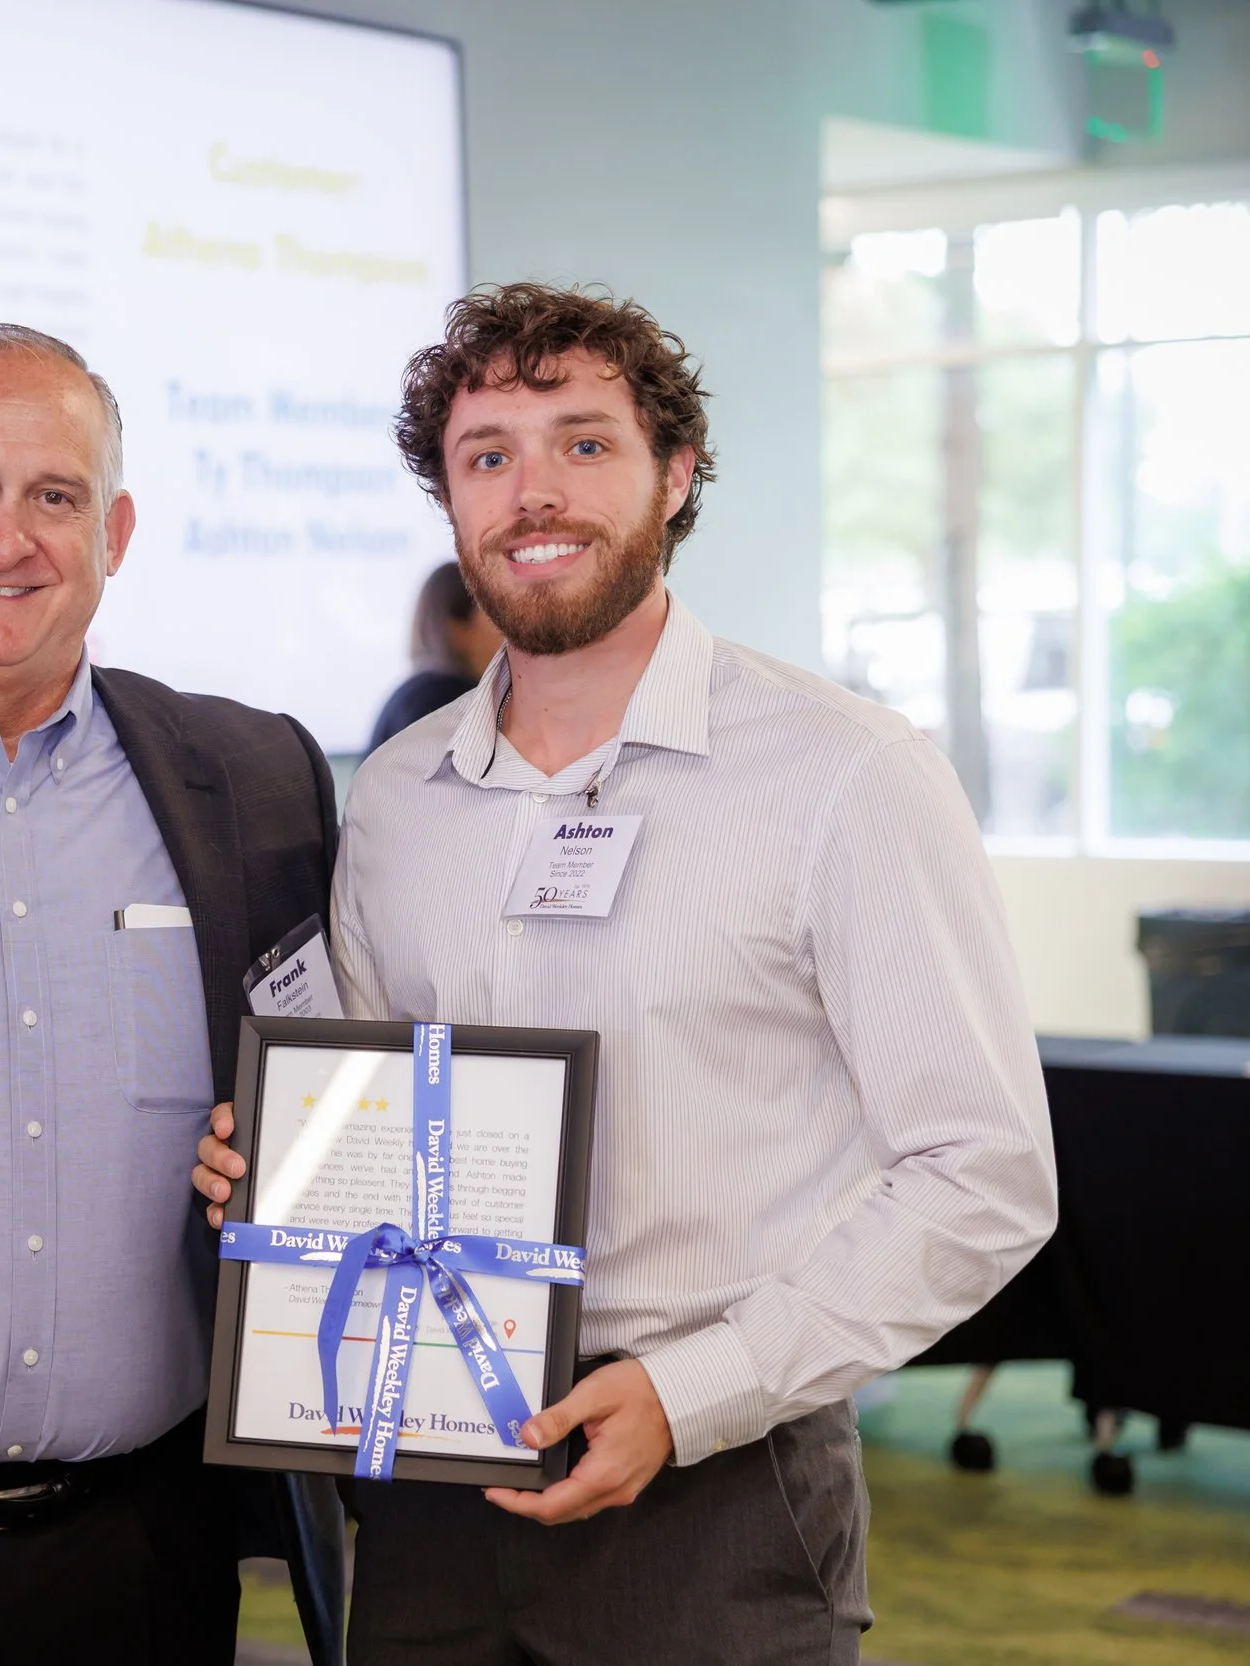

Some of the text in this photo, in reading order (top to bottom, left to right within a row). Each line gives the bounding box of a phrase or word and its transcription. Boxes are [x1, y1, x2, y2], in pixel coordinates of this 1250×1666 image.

[553, 822, 614, 840] Ashton
[560, 846, 593, 856] Nelson
[549, 860, 594, 869] Team Member
[550, 870, 568, 878] Since
[530, 886, 558, 910] 50
[559, 890, 589, 899] YEARS
[269, 958, 308, 998] Frank
[276, 981, 309, 1012] Falkstein
[428, 1023, 446, 1085] Homes
[346, 1135, 370, 1145] David
[374, 1137, 404, 1149] Weekly
[474, 1144, 488, 1152] are
[492, 1145, 511, 1154] over
[515, 1145, 529, 1154] the
[456, 1129, 471, 1139] just
[476, 1130, 504, 1139] closed
[427, 1119, 445, 1173] David
[347, 1151, 364, 1159] was
[367, 1151, 379, 1161] by
[382, 1151, 393, 1160] far
[449, 1156, 468, 1165] best
[471, 1156, 496, 1166] home
[499, 1158, 528, 1169] buying
[350, 1164, 374, 1173] we've
[380, 1165, 397, 1174] had
[466, 1170, 496, 1180] Ashton
[502, 1172, 527, 1181] made
[390, 1179, 410, 1190] They
[457, 1183, 490, 1194] through
[491, 1185, 527, 1197] begging
[324, 1188, 340, 1198] and
[345, 1190, 359, 1199] the
[384, 1193, 402, 1203] with
[470, 1198, 481, 1206] of
[484, 1199, 525, 1210] customer
[427, 1174, 445, 1240] Weekle
[322, 1204, 346, 1214] every
[348, 1205, 372, 1215] single
[462, 1212, 478, 1221] feel
[480, 1214, 492, 1222] so
[494, 1214, 524, 1225] special
[289, 1215, 523, 1240] and were very orward to getting
[270, 1230, 324, 1250] David
[495, 1242, 550, 1266] David
[289, 1282, 319, 1294] Athena
[288, 1294, 311, 1305] David
[393, 1285, 418, 1340] David
[462, 1336, 501, 1392] David
[377, 1340, 408, 1419] Weekley
[288, 1402, 344, 1424] Davd
[430, 1412, 495, 1435] Homes
